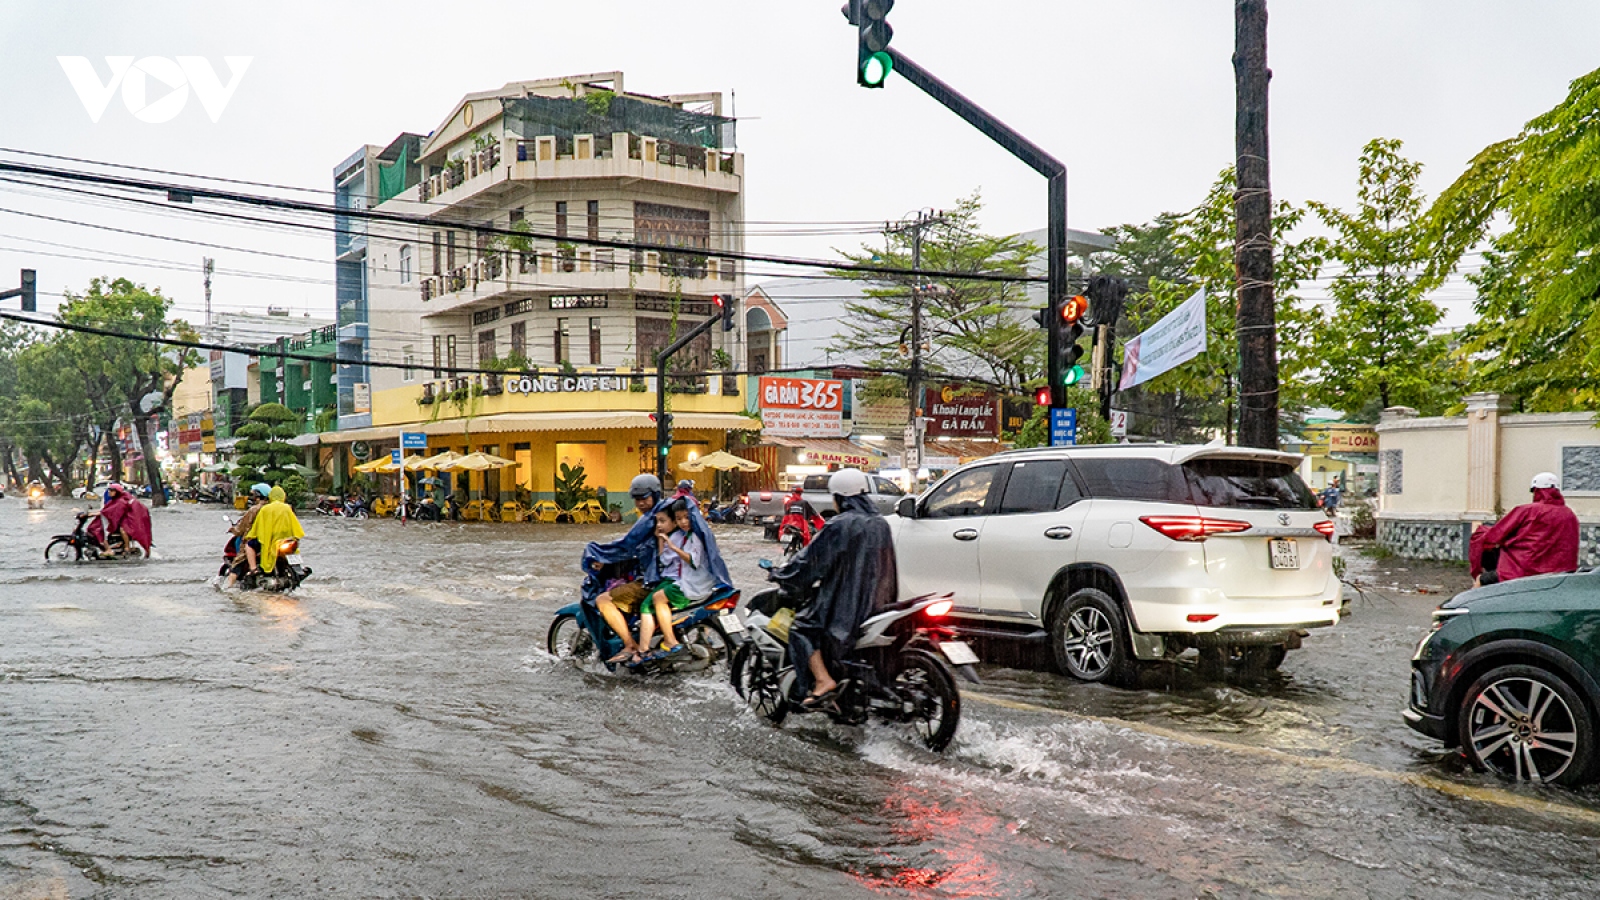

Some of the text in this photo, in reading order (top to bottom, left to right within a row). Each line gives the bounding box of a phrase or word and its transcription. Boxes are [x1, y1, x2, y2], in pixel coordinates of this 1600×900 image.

[507, 376, 558, 397] CỘNG
[615, 376, 628, 391] II
[765, 380, 779, 404] GÀ
[780, 381, 799, 405] RÁN
[800, 380, 842, 409] 365
[932, 403, 959, 416] Khoai
[958, 404, 980, 418] Lang
[941, 415, 986, 430] GÀ RÁN
[1348, 435, 1377, 447] LOAN
[844, 455, 869, 466] 365
